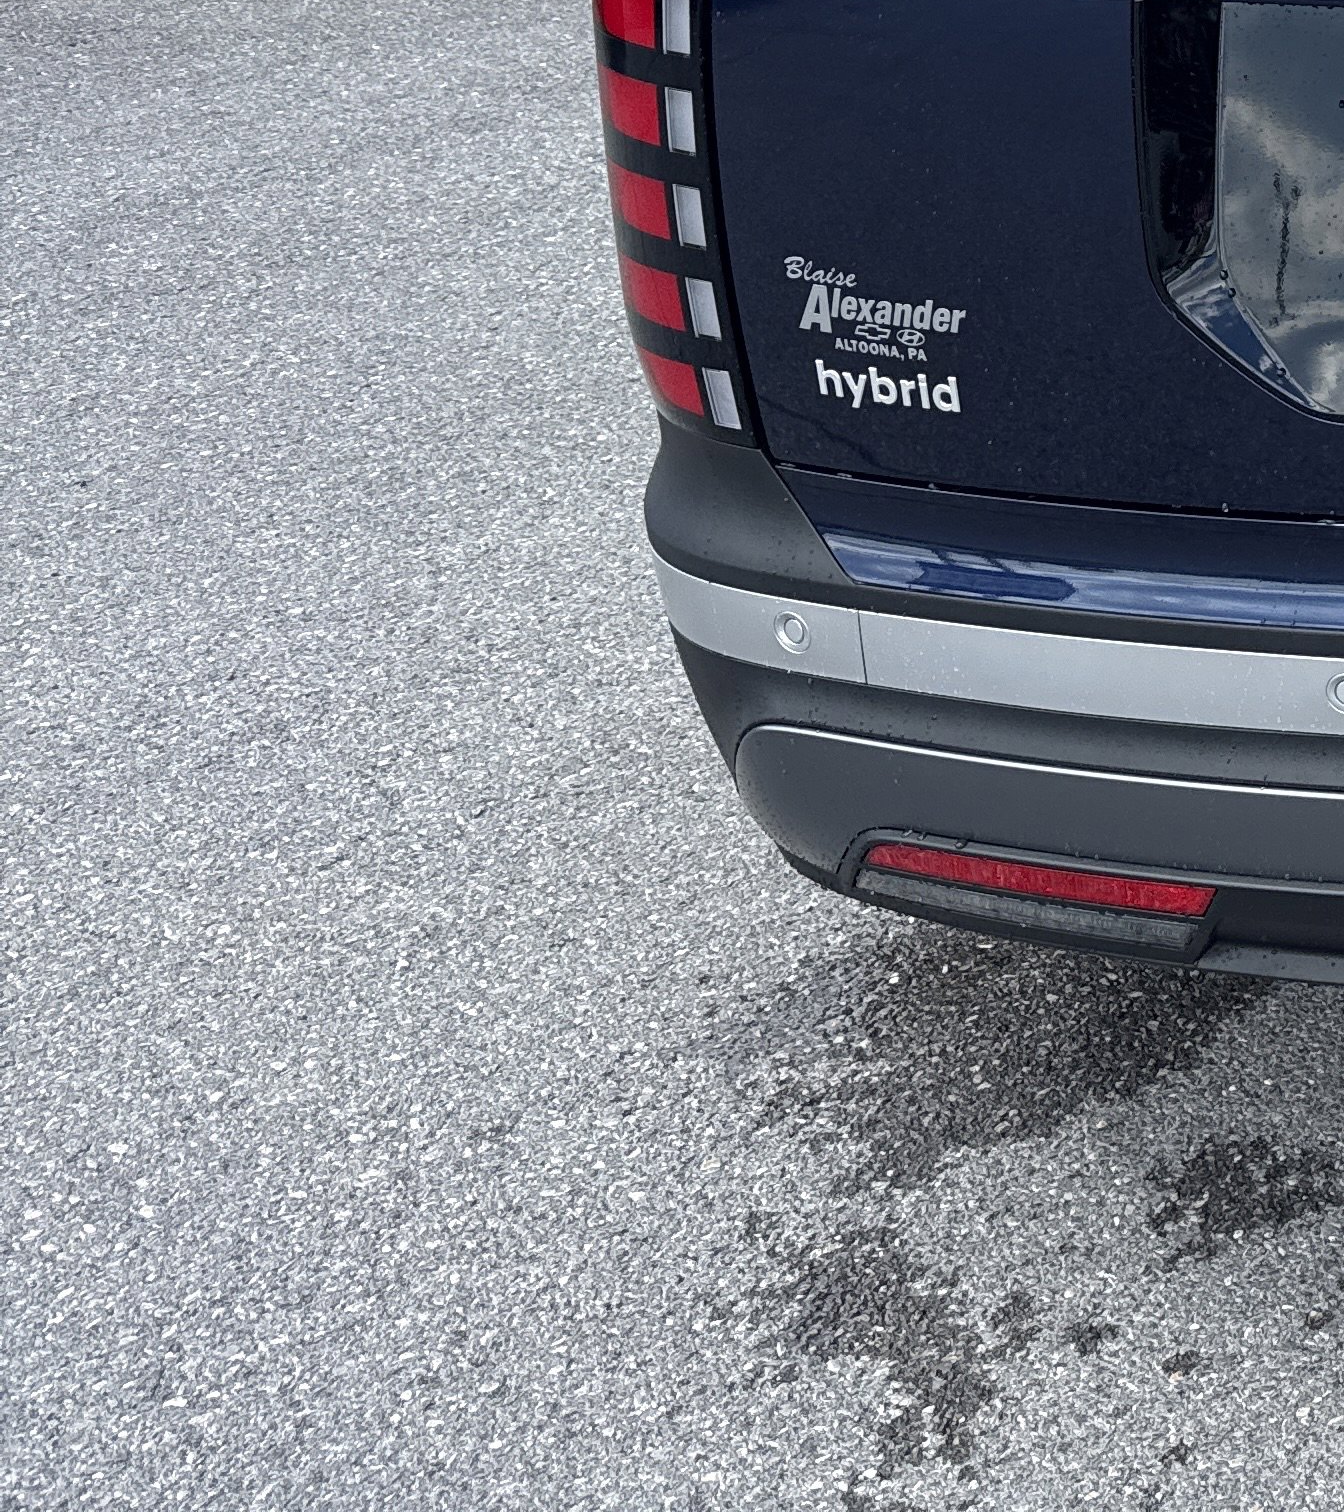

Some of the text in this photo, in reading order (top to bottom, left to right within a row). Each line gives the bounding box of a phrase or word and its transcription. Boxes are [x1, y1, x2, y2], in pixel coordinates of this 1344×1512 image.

[783, 256, 858, 287] Blaise
[799, 283, 967, 334] Alexander
[834, 337, 928, 362] ALTOONA, PA
[814, 359, 962, 413] hybrid
